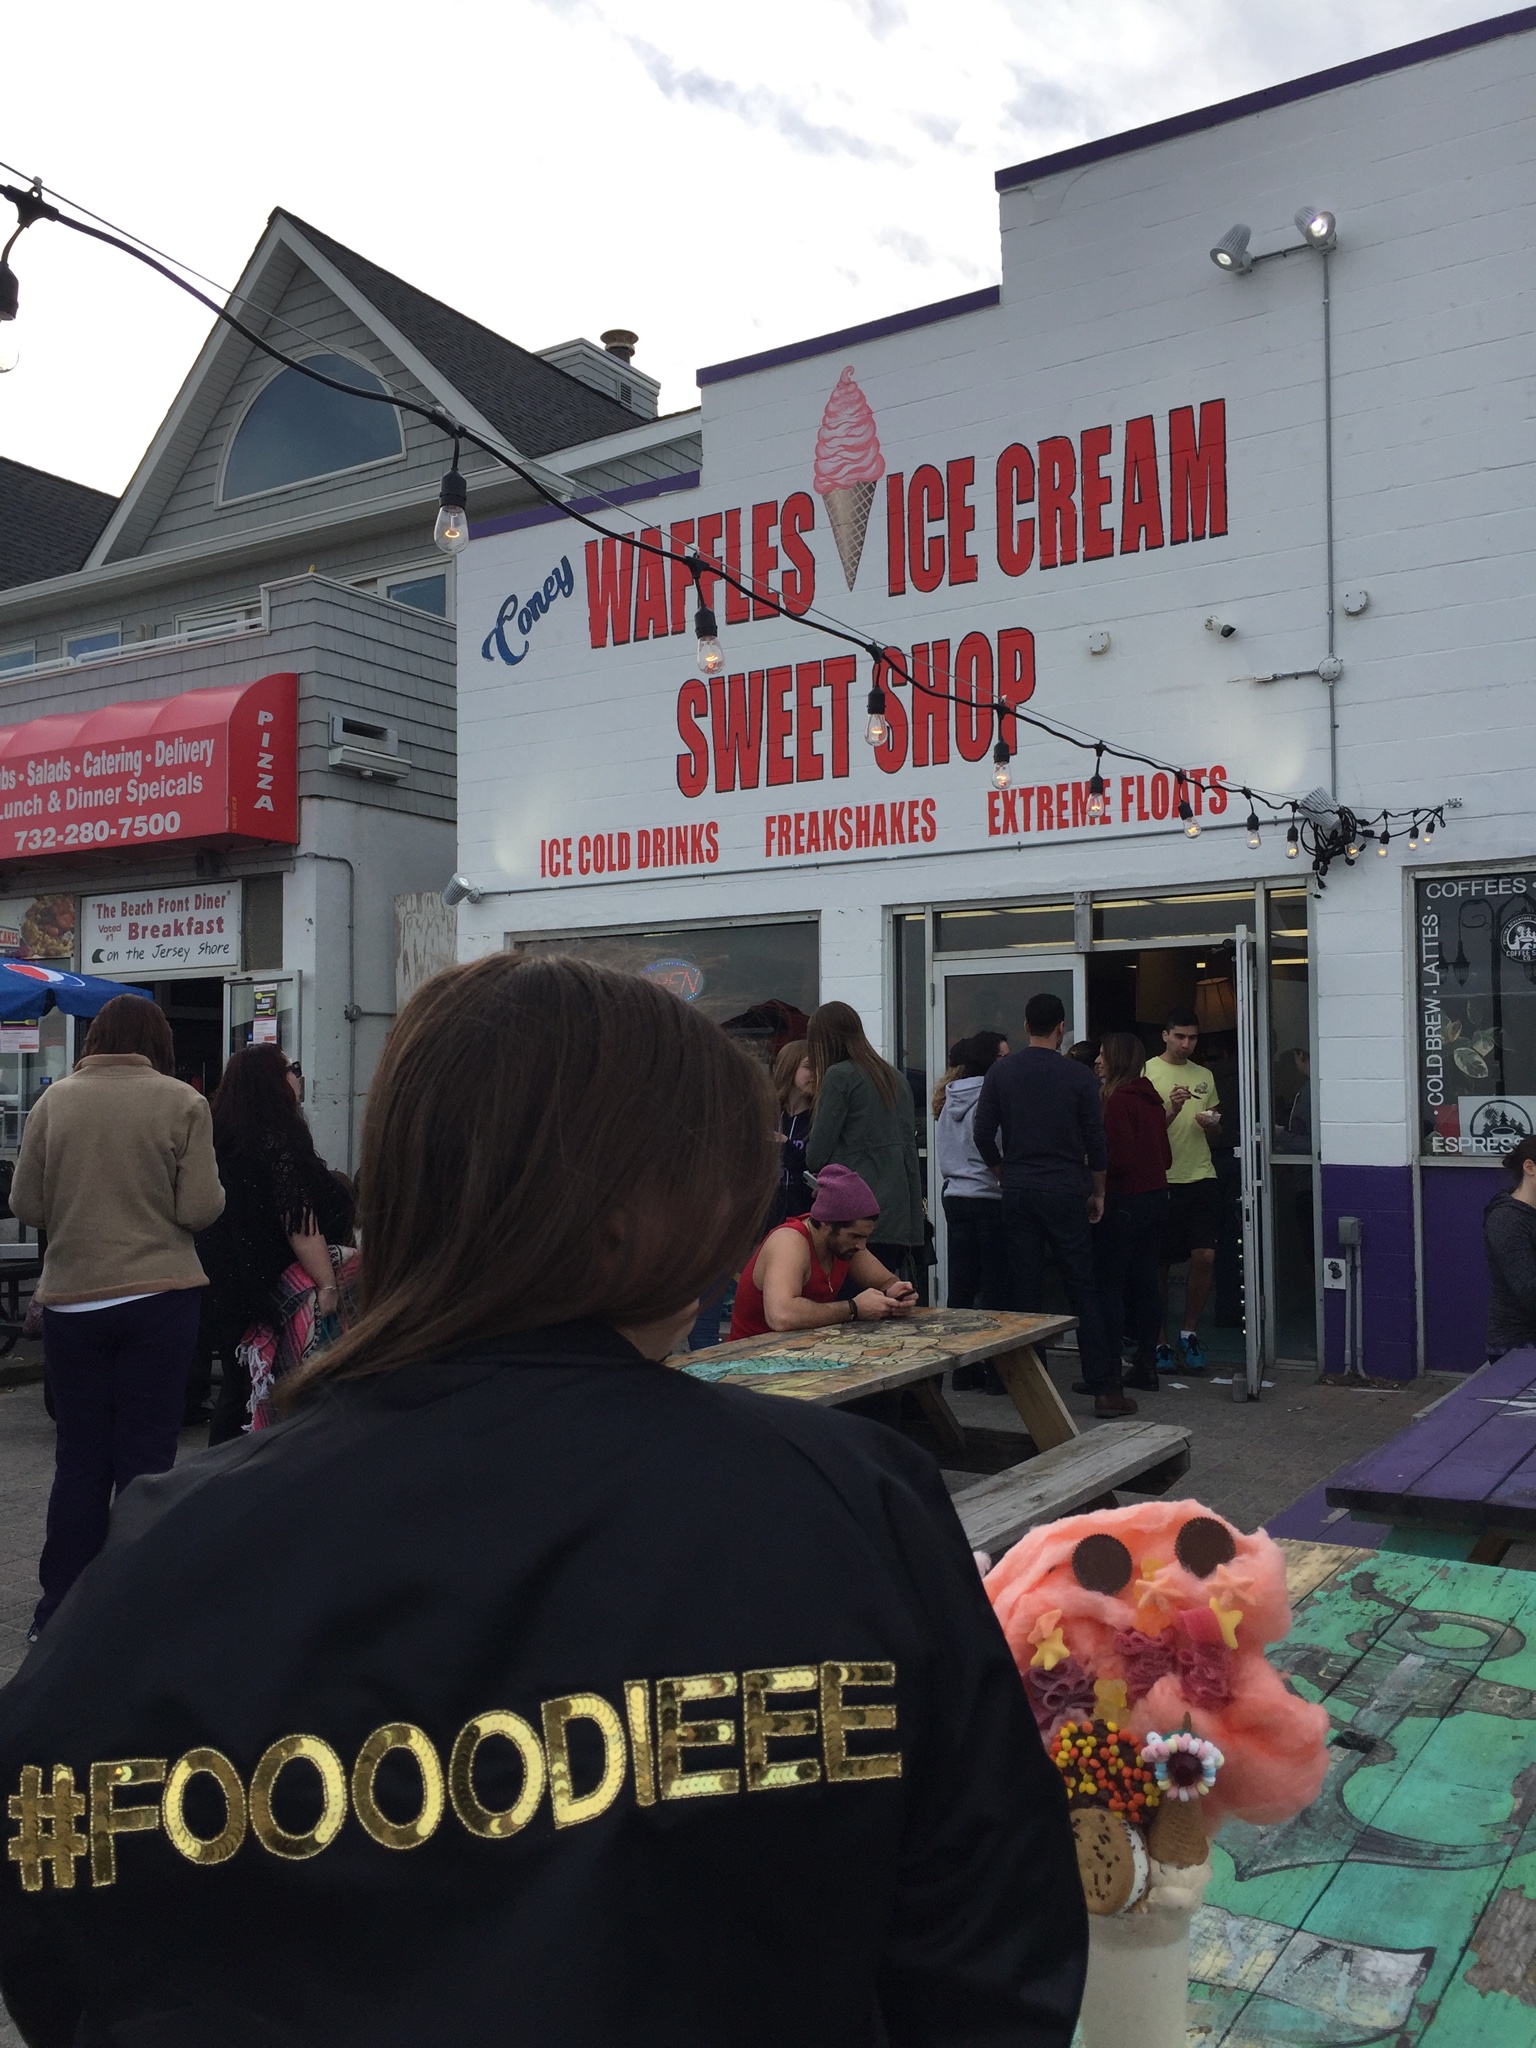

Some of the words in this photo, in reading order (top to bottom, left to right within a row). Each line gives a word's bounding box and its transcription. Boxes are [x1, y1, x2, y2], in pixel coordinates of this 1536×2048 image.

[482, 555, 574, 666] Coney
[585, 491, 815, 649] WAFFLES
[887, 456, 978, 597] ICE
[995, 398, 1228, 577] CREAM
[677, 654, 857, 798] SWEET
[872, 627, 1036, 774] SHOP
[0, 765, 16, 790] bs
[27, 756, 71, 786] Salads
[83, 745, 142, 777] Catering
[155, 736, 214, 768] Delivery
[253, 710, 274, 812] PIZZA
[47, 790, 61, 813] &
[66, 786, 122, 811] Dinner
[126, 771, 203, 806] Speicals
[988, 779, 1112, 837] EXTREME
[1120, 765, 1228, 823] FLOATS
[15, 811, 180, 851] 732-280-7500
[541, 837, 572, 878] ICE
[578, 832, 631, 875] COLD
[637, 821, 719, 869] DRINKS
[765, 798, 937, 857] FREAKSHAKES
[121, 899, 153, 917] Beach
[158, 896, 190, 914] Front
[1426, 878, 1527, 899] COFFEES
[98, 923, 122, 934] Voted
[107, 951, 119, 961] on
[125, 947, 145, 960] the
[152, 943, 191, 963] Jersey
[128, 916, 225, 940] Breakfast
[1421, 913, 1440, 987] LATTES
[1424, 998, 1443, 1051] BREW
[1426, 1054, 1444, 1106] COLD
[8, 1661, 901, 1891] #FOOOODIEEE
